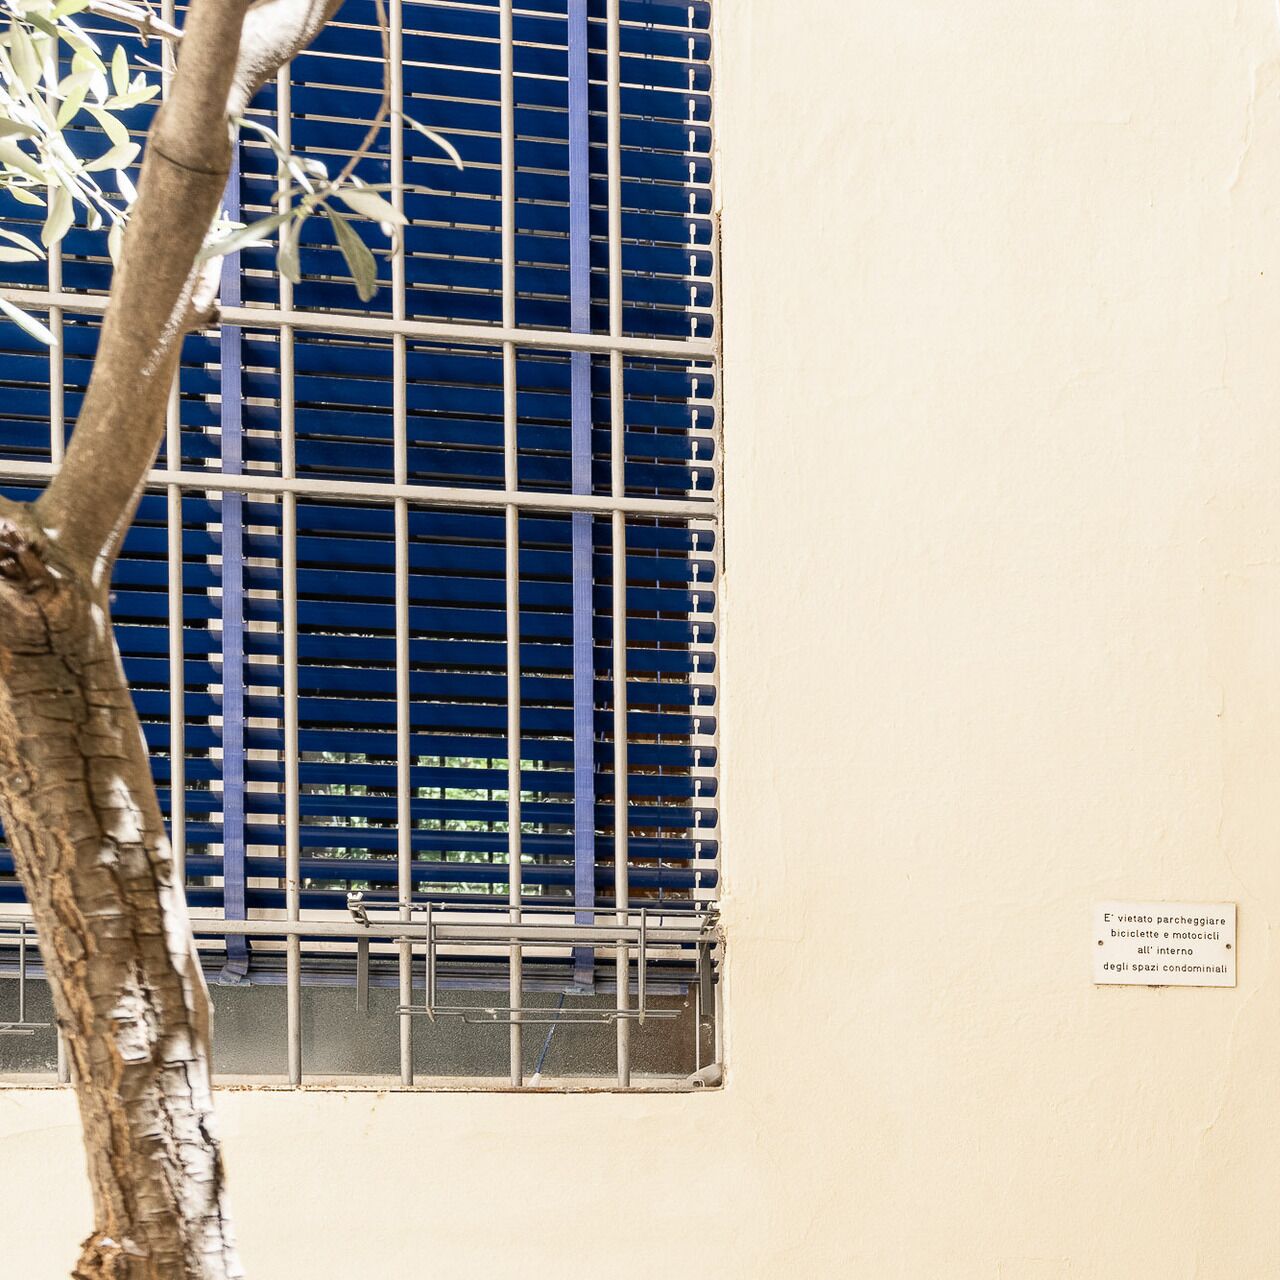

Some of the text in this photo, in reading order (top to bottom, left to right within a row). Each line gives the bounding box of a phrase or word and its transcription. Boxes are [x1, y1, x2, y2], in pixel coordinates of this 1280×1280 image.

[1117, 914, 1153, 923] vietato
[1157, 916, 1226, 927] parcheggiare
[1111, 929, 1159, 938] biciclette
[1172, 931, 1219, 940] motocicli
[1137, 946, 1193, 956] all' interno
[1103, 962, 1227, 973] degli spazi condominiali
